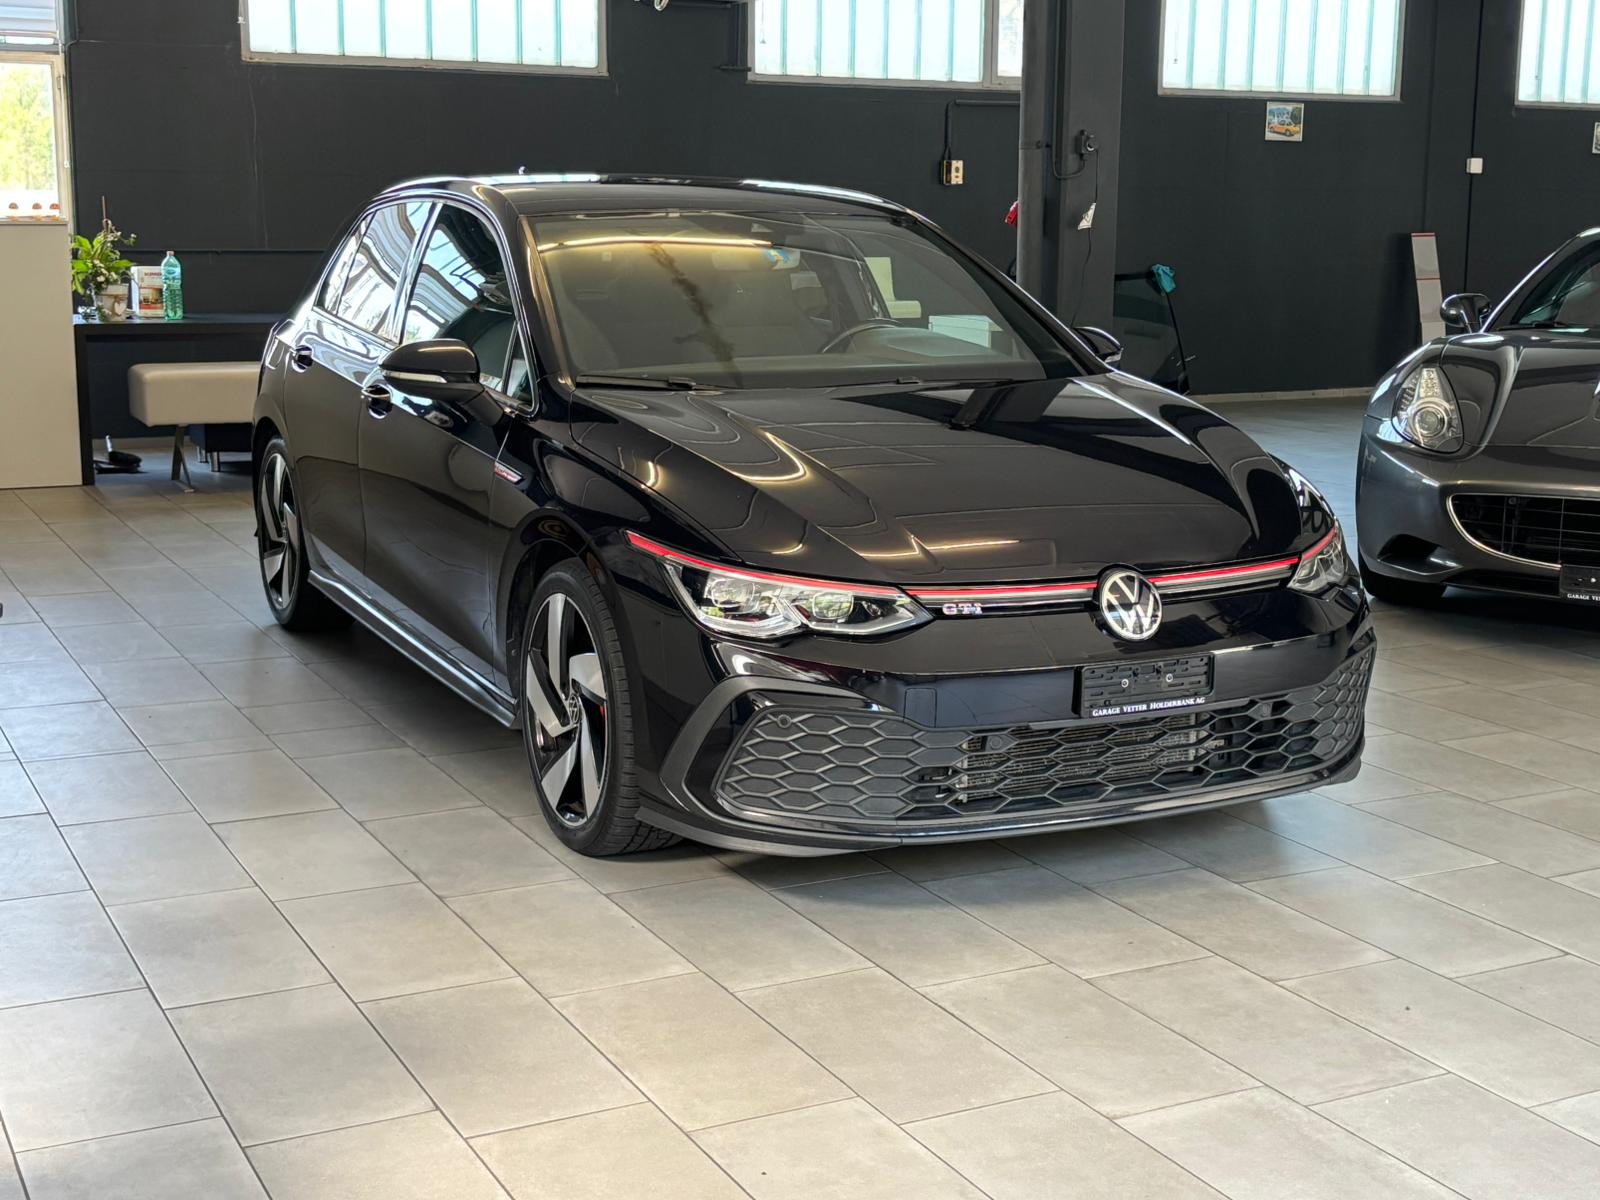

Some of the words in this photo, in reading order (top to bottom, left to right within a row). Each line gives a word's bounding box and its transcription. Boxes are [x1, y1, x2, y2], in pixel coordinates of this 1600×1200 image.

[942, 603, 982, 615] GTI
[1092, 706, 1121, 716] GARAGE
[1123, 702, 1147, 713] VETTER
[1149, 698, 1196, 710] HOLDERBANK
